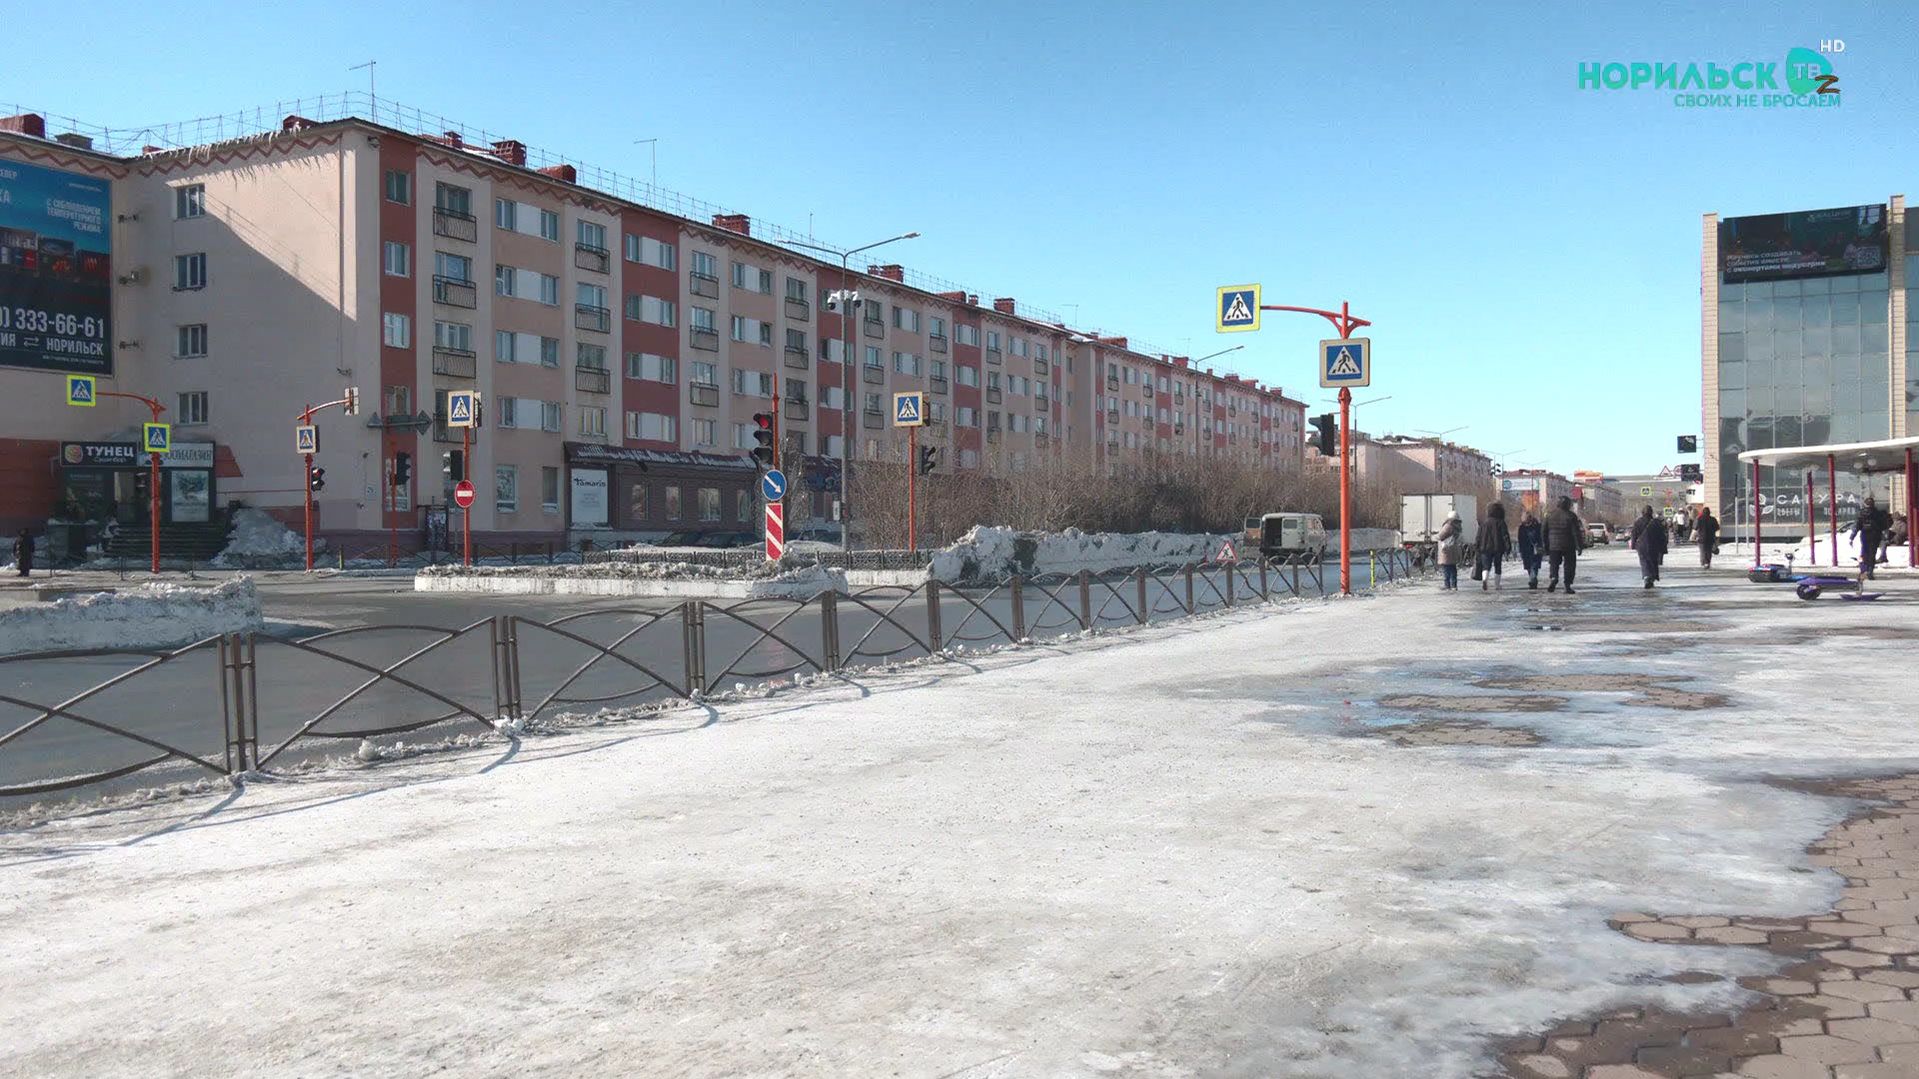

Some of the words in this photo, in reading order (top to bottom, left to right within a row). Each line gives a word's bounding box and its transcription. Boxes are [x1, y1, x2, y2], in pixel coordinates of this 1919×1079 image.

[15, 307, 104, 339] 333-66-61
[46, 337, 104, 355] НОРИЛЬСК
[86, 445, 134, 458] ТУНЕЦ
